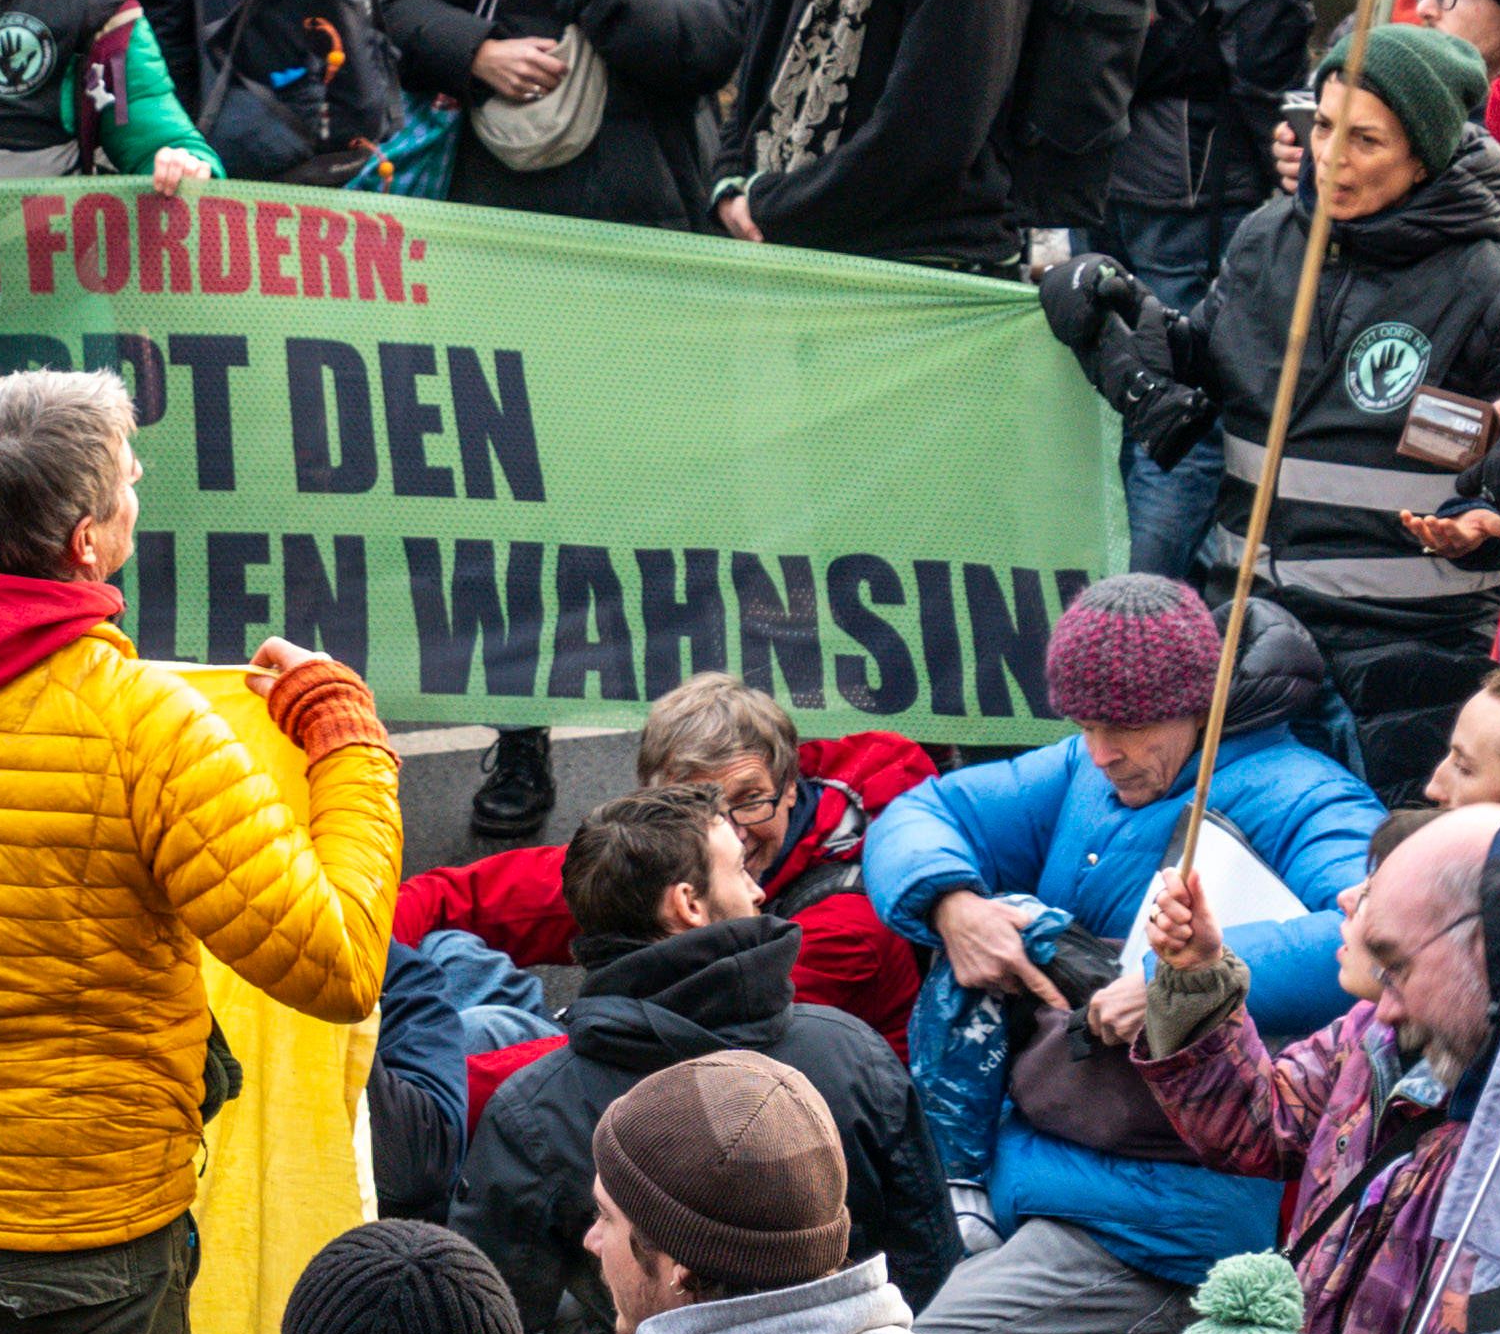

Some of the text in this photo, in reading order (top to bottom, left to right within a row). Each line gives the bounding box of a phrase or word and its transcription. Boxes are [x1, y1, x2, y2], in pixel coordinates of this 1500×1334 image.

[23, 191, 431, 307] FORDERN:
[286, 336, 548, 503] DEN
[402, 535, 1089, 722] WAHNSIN
